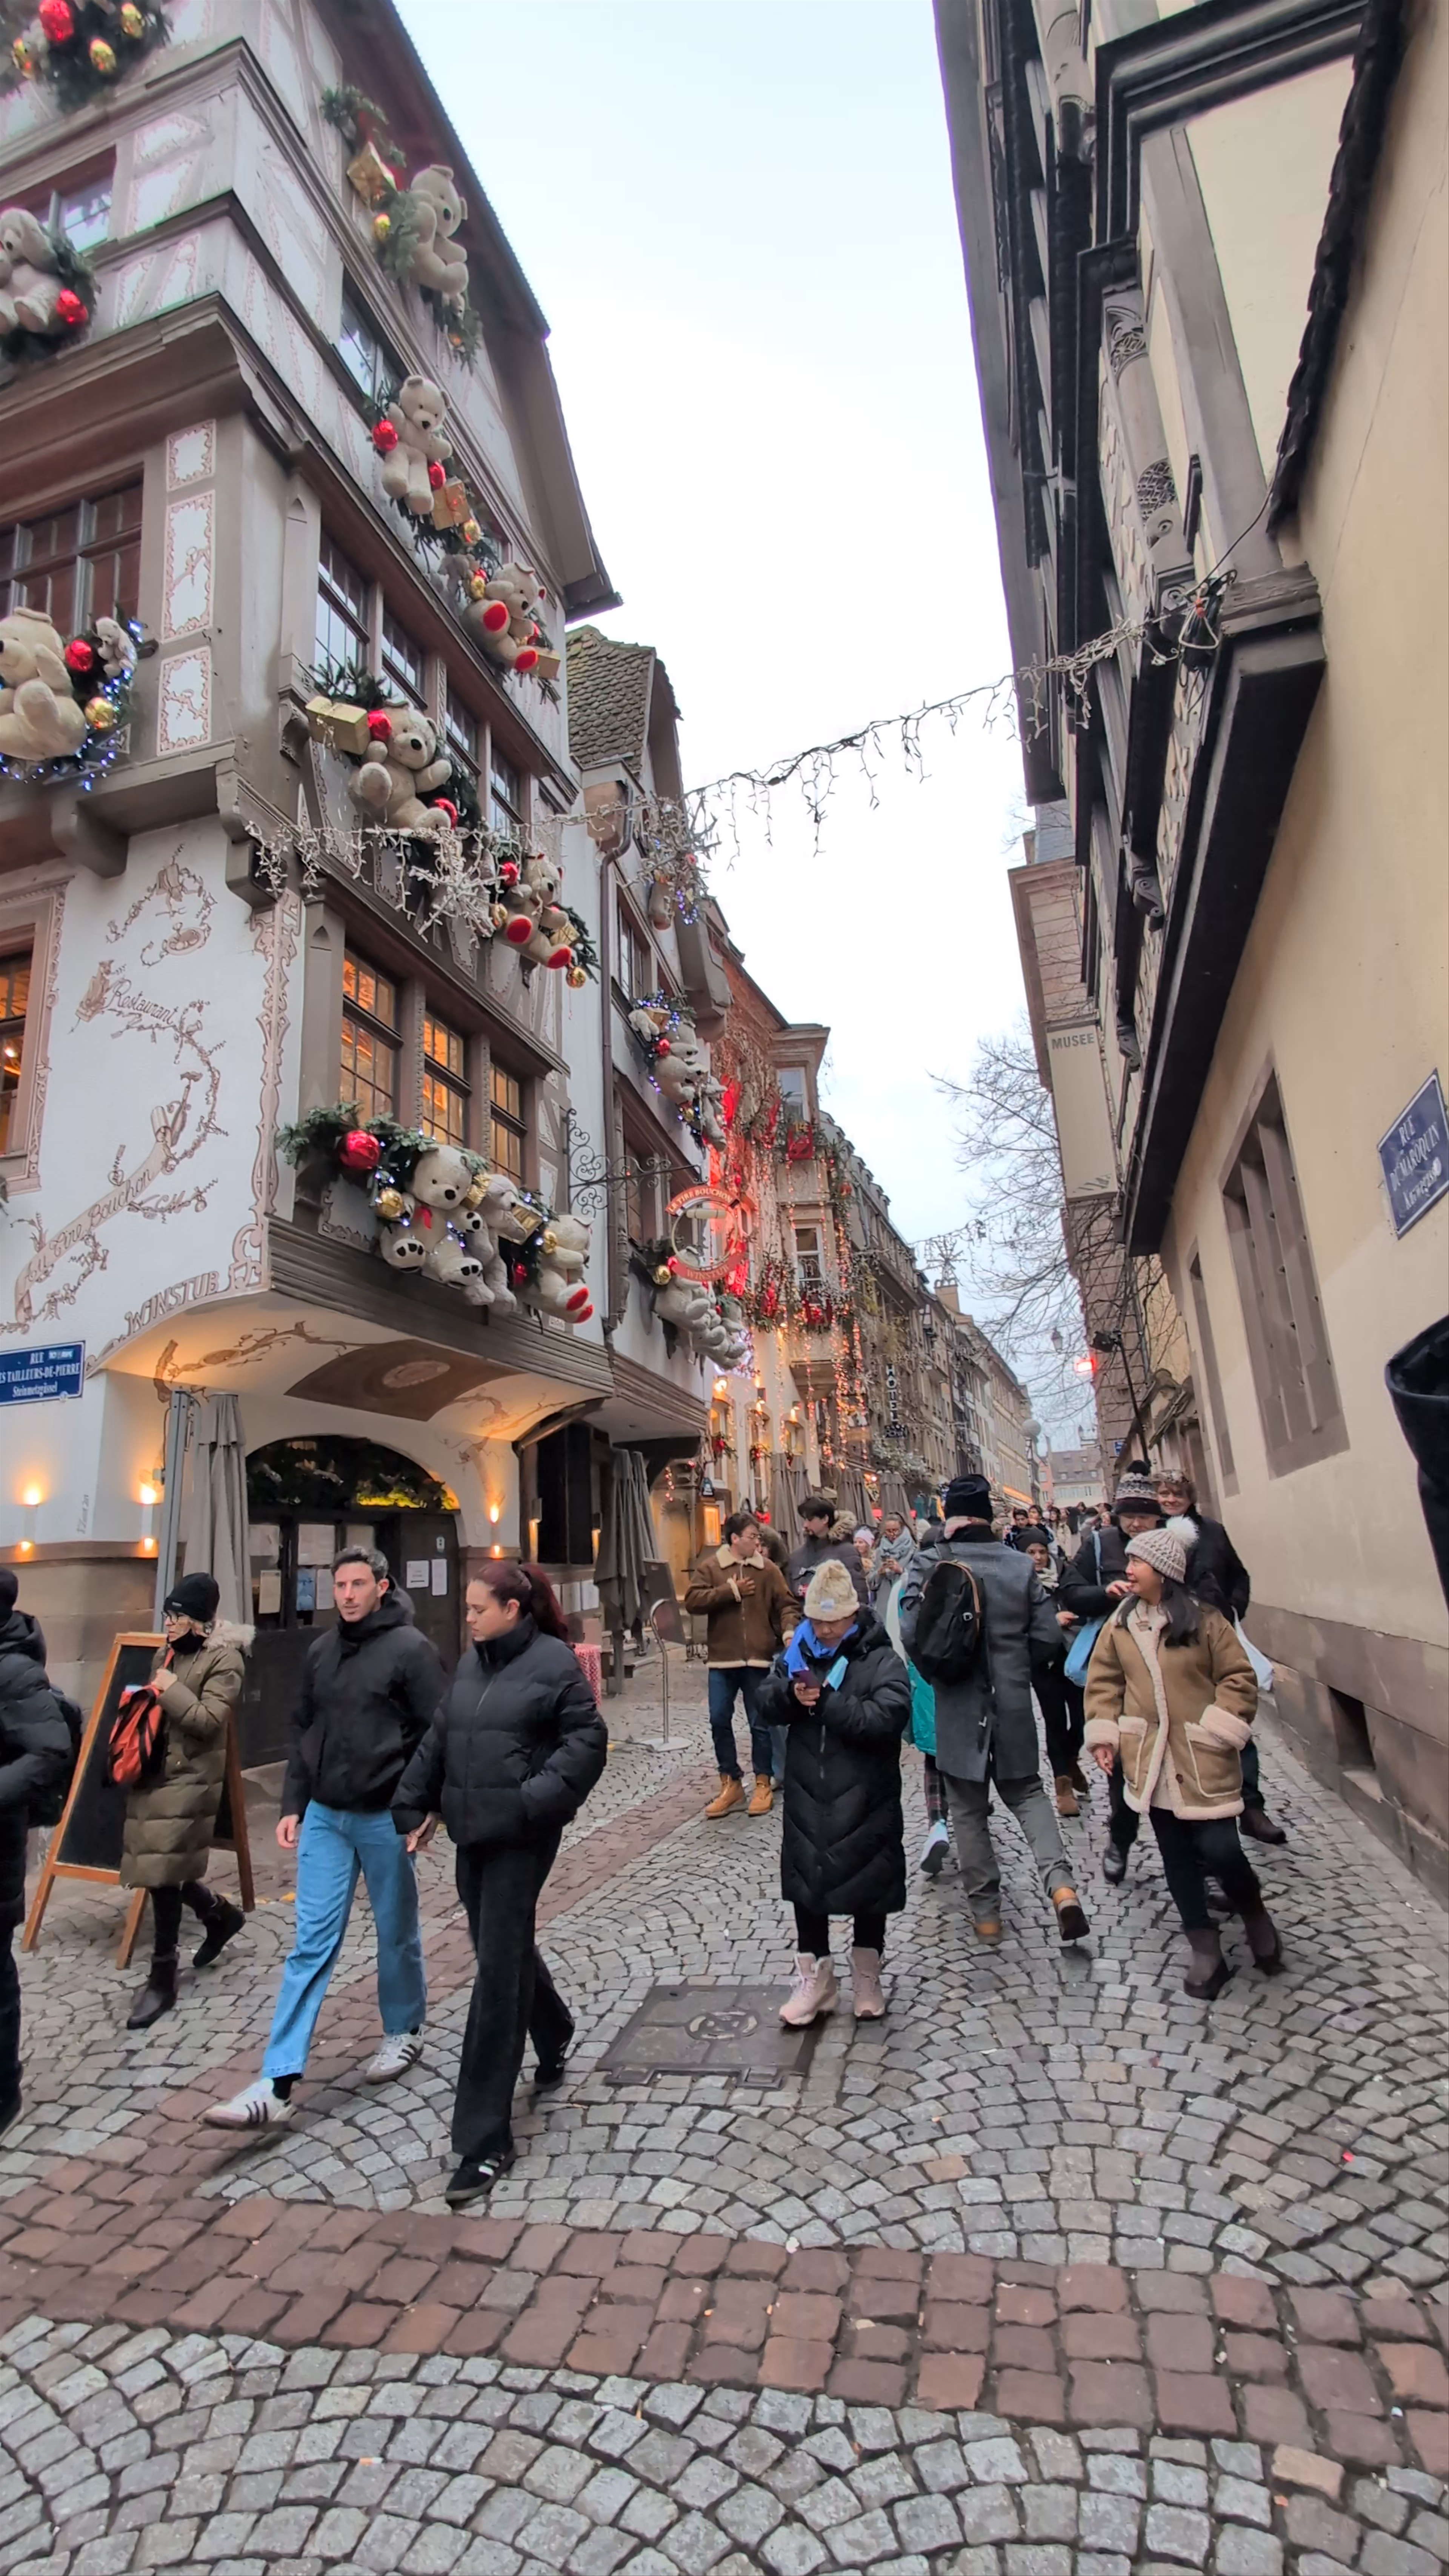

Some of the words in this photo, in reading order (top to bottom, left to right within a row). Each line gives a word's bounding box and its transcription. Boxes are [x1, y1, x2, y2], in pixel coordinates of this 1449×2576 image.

[100, 978, 179, 1025] Restaurant
[1052, 1033, 1095, 1050] MUSEE
[1398, 1114, 1415, 1147] RUE
[1399, 1121, 1440, 1178] MAROQUIN
[88, 1169, 151, 1229] Bouchon
[677, 1191, 695, 1204] TIRE
[695, 1188, 733, 1203] BOUCHON
[125, 1271, 220, 1337] WINSTUB
[7, 1363, 80, 1383] TAILLEURS-DE-PIERRE
[29, 1352, 45, 1364] RUE
